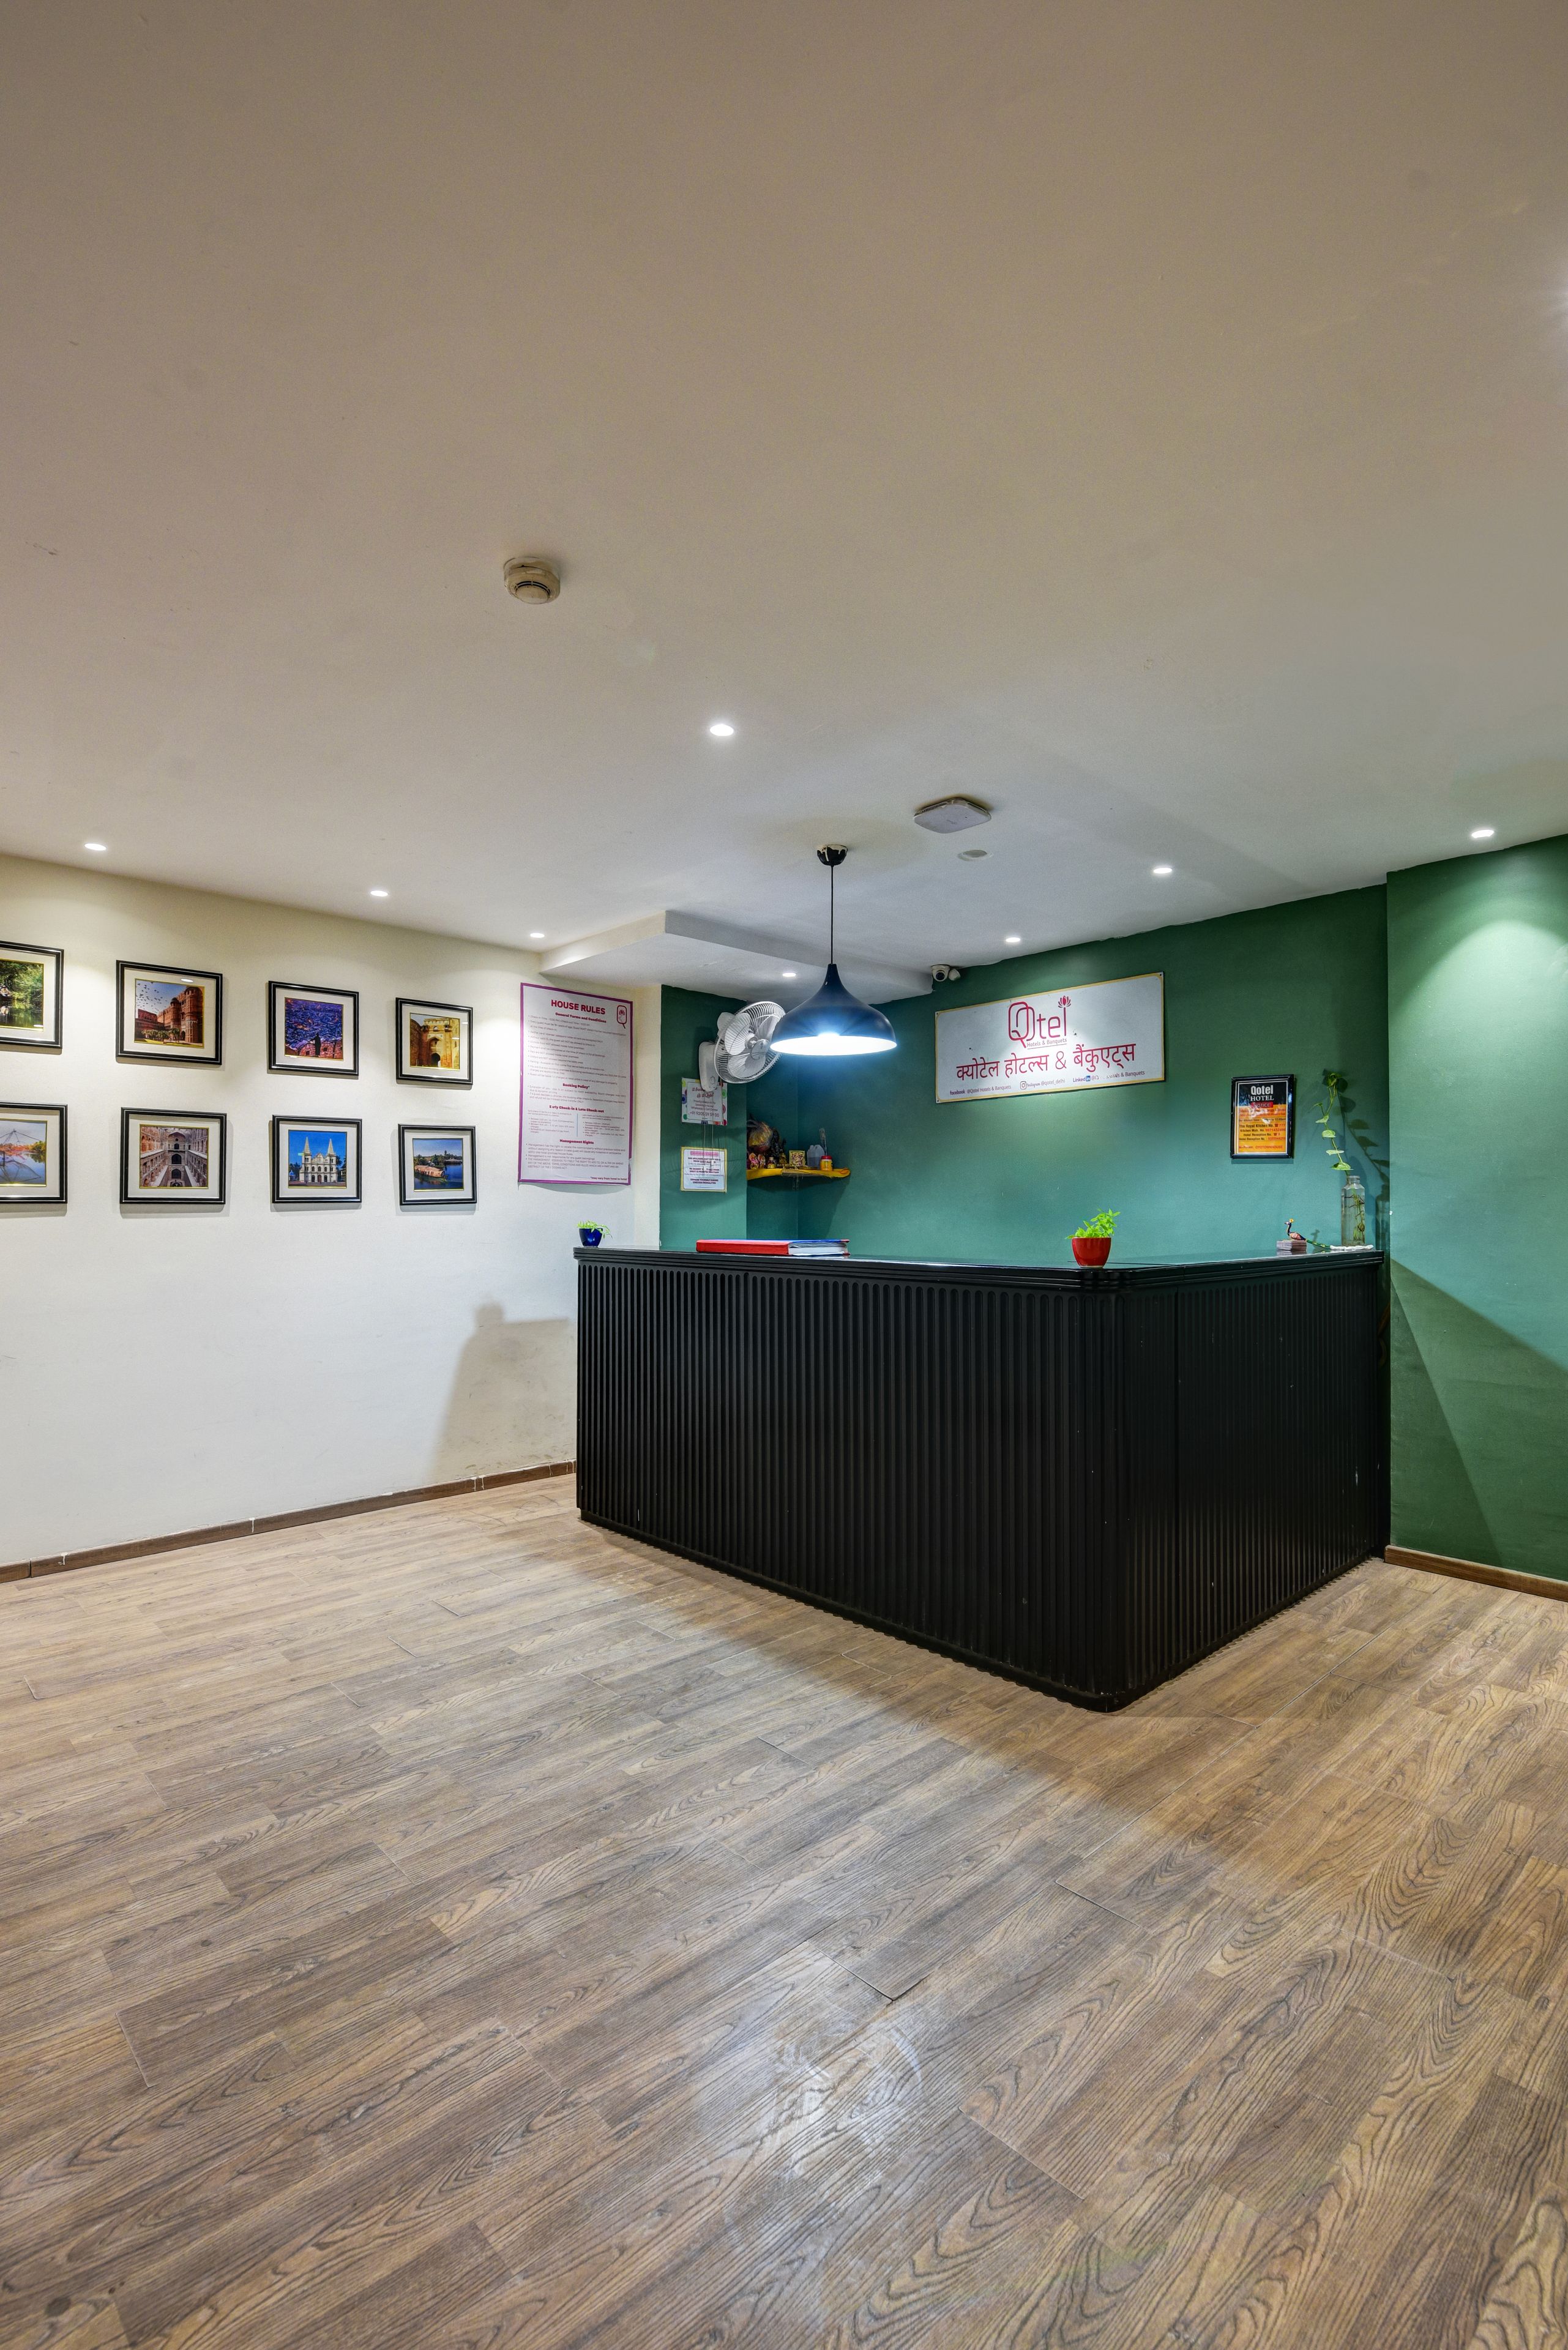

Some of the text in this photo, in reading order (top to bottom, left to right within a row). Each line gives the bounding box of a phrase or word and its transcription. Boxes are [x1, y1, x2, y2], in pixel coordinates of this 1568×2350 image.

[551, 999, 605, 1015] HOUSE RULES
[956, 1056, 1000, 1081] क्योटेल
[1004, 1053, 1050, 1078] होटल्स
[1055, 1051, 1067, 1070] &
[1250, 1084, 1274, 1095] Qotel
